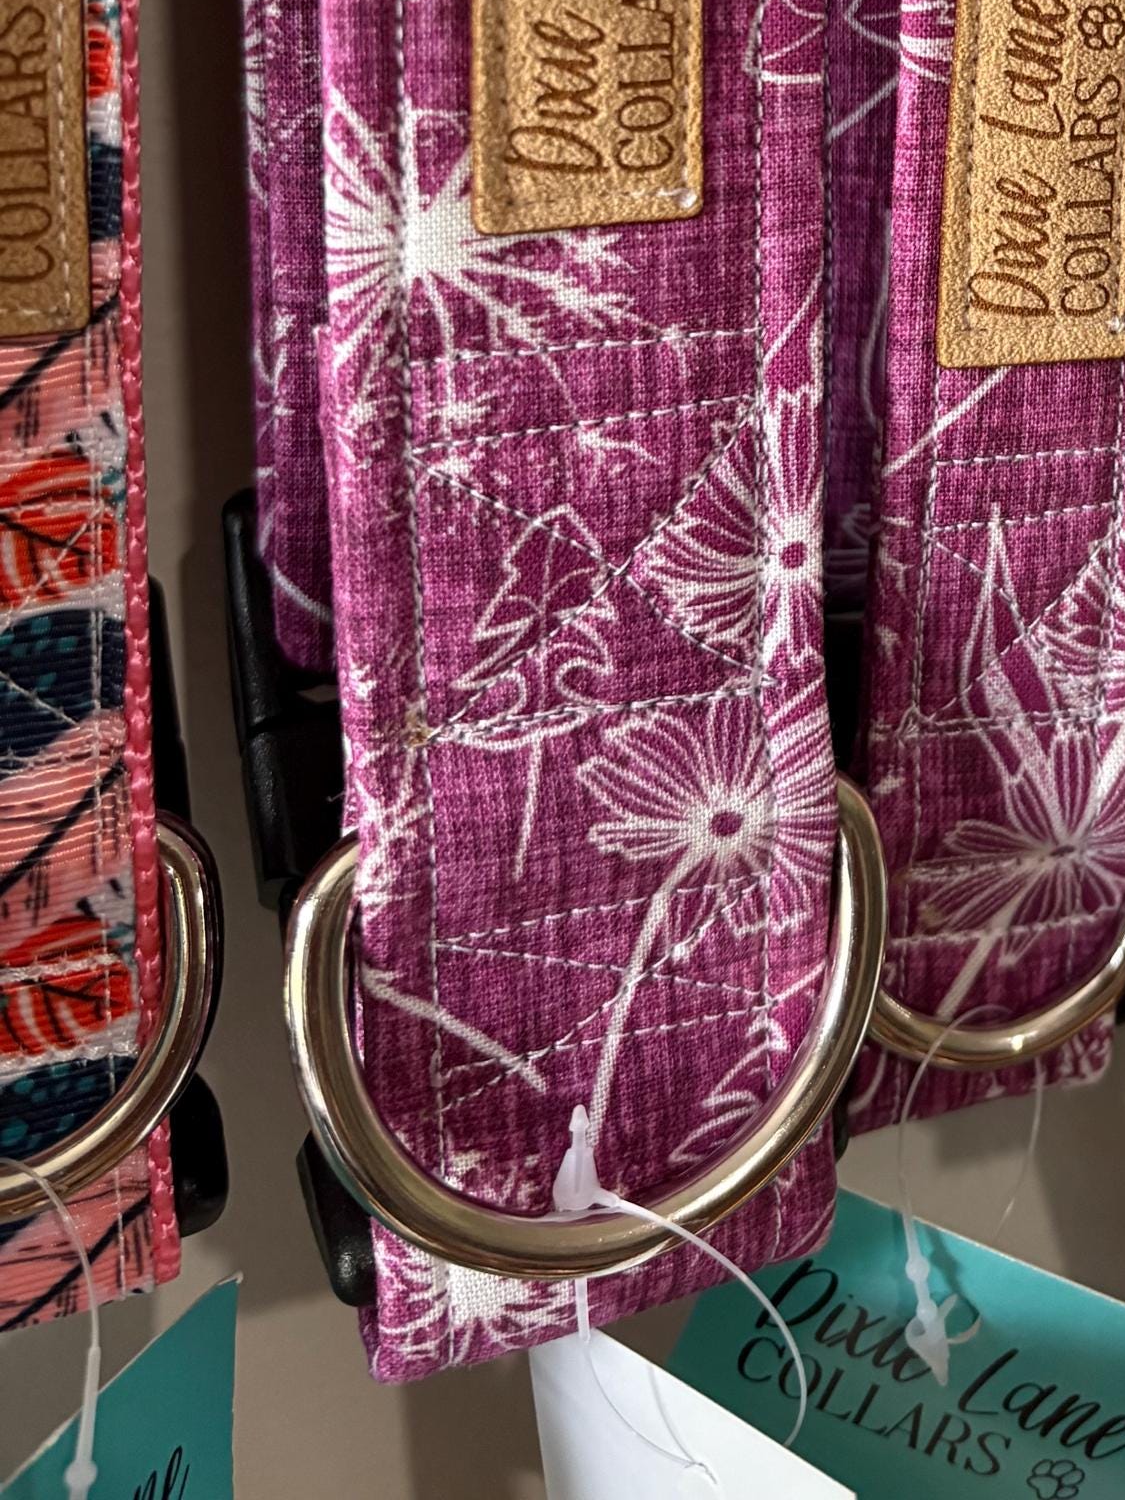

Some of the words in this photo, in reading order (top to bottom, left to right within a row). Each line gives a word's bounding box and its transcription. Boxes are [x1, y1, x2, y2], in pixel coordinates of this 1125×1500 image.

[0, 5, 54, 283] COLLARS
[504, 10, 609, 173] Dixie
[968, 168, 1057, 318] Dixie
[1061, 73, 1121, 318] COLLARS
[737, 1336, 1011, 1476] COLLARS
